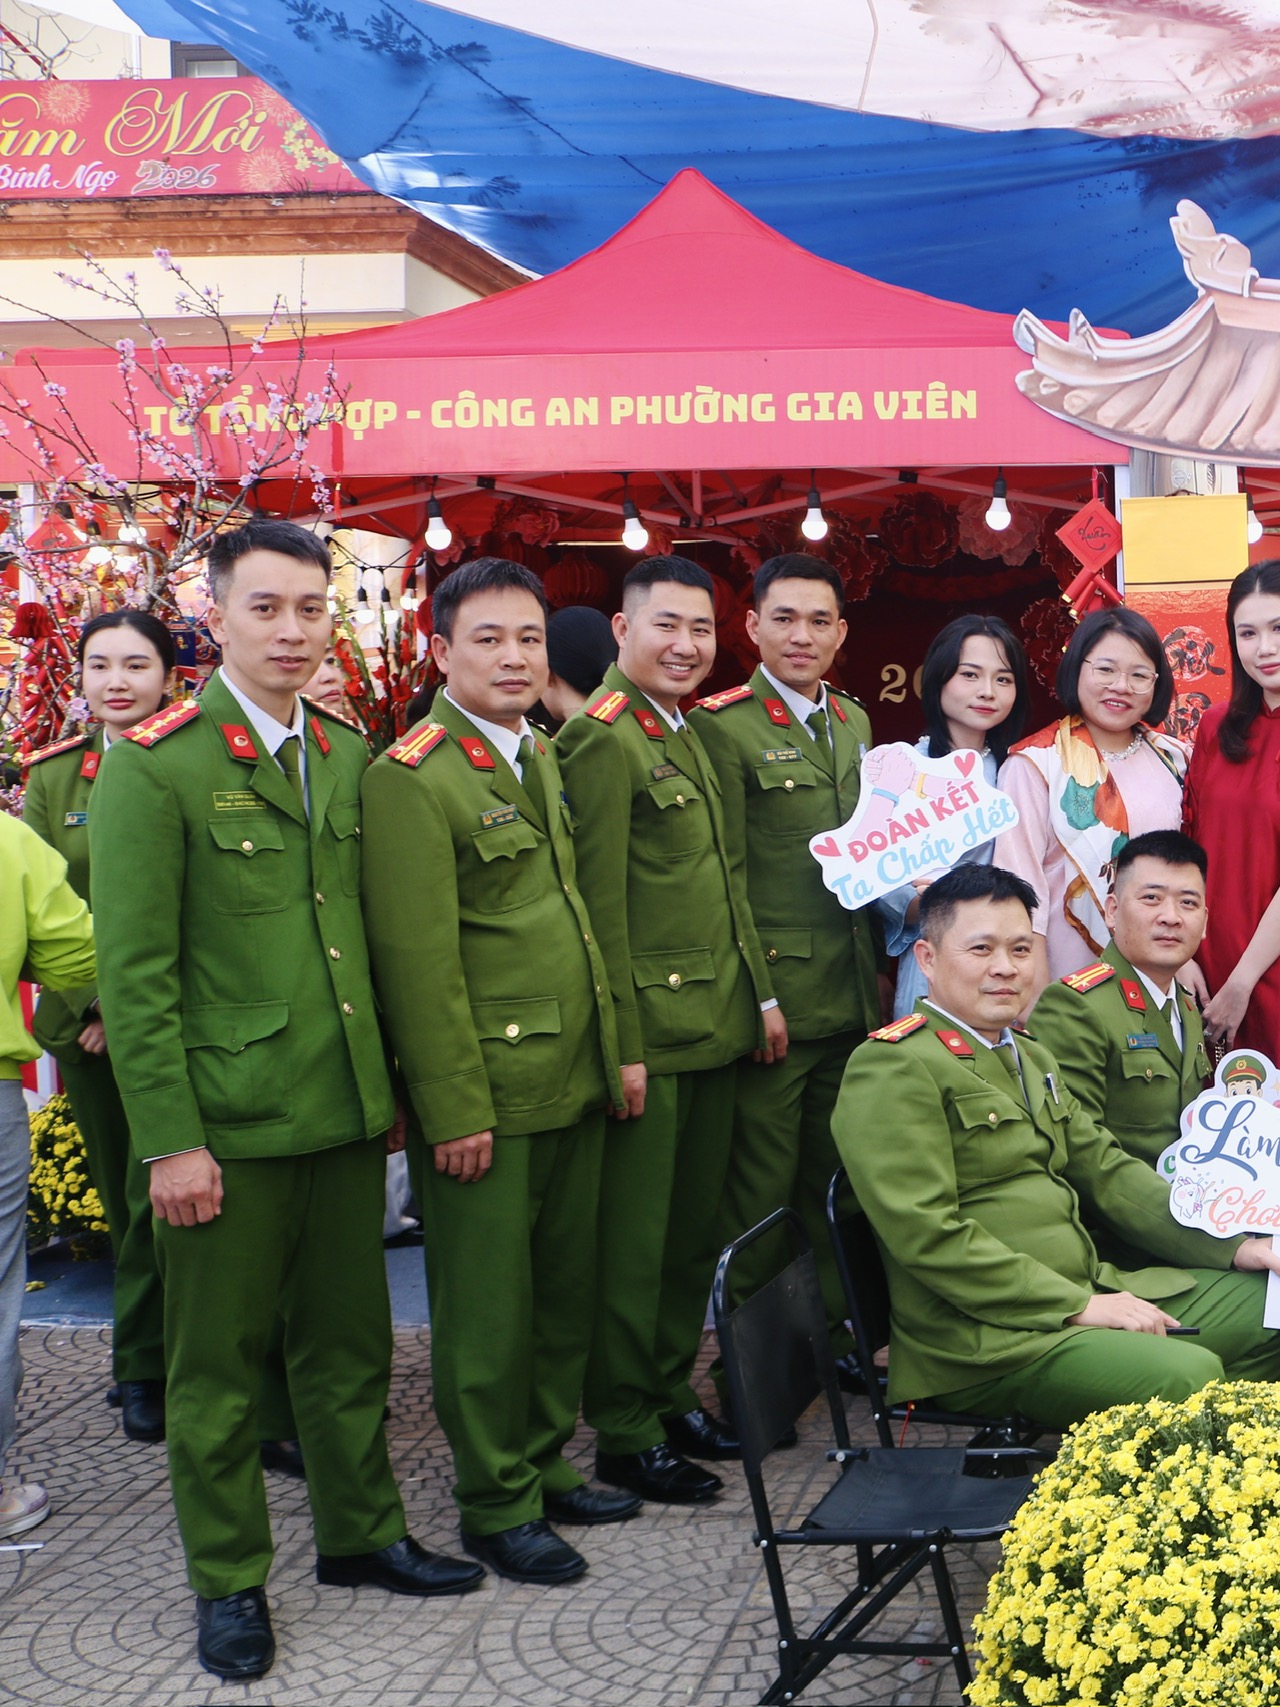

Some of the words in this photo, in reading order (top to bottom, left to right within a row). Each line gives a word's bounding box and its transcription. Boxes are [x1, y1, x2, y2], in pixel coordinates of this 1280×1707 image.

[0, 93, 86, 156] ăm
[104, 88, 267, 157] Mới
[53, 161, 119, 195] Ngọ
[131, 159, 221, 195] 2026
[431, 389, 535, 428] CÔNG
[545, 397, 599, 426] AN
[611, 385, 776, 425] PHƯỜNG
[787, 391, 863, 421] GIA
[873, 381, 977, 420] VIÊN
[831, 873, 873, 906] Ta
[877, 833, 955, 884] Chấp
[962, 797, 1015, 846] Hết
[847, 808, 930, 863] ĐOÀN
[930, 780, 981, 821] KẾT
